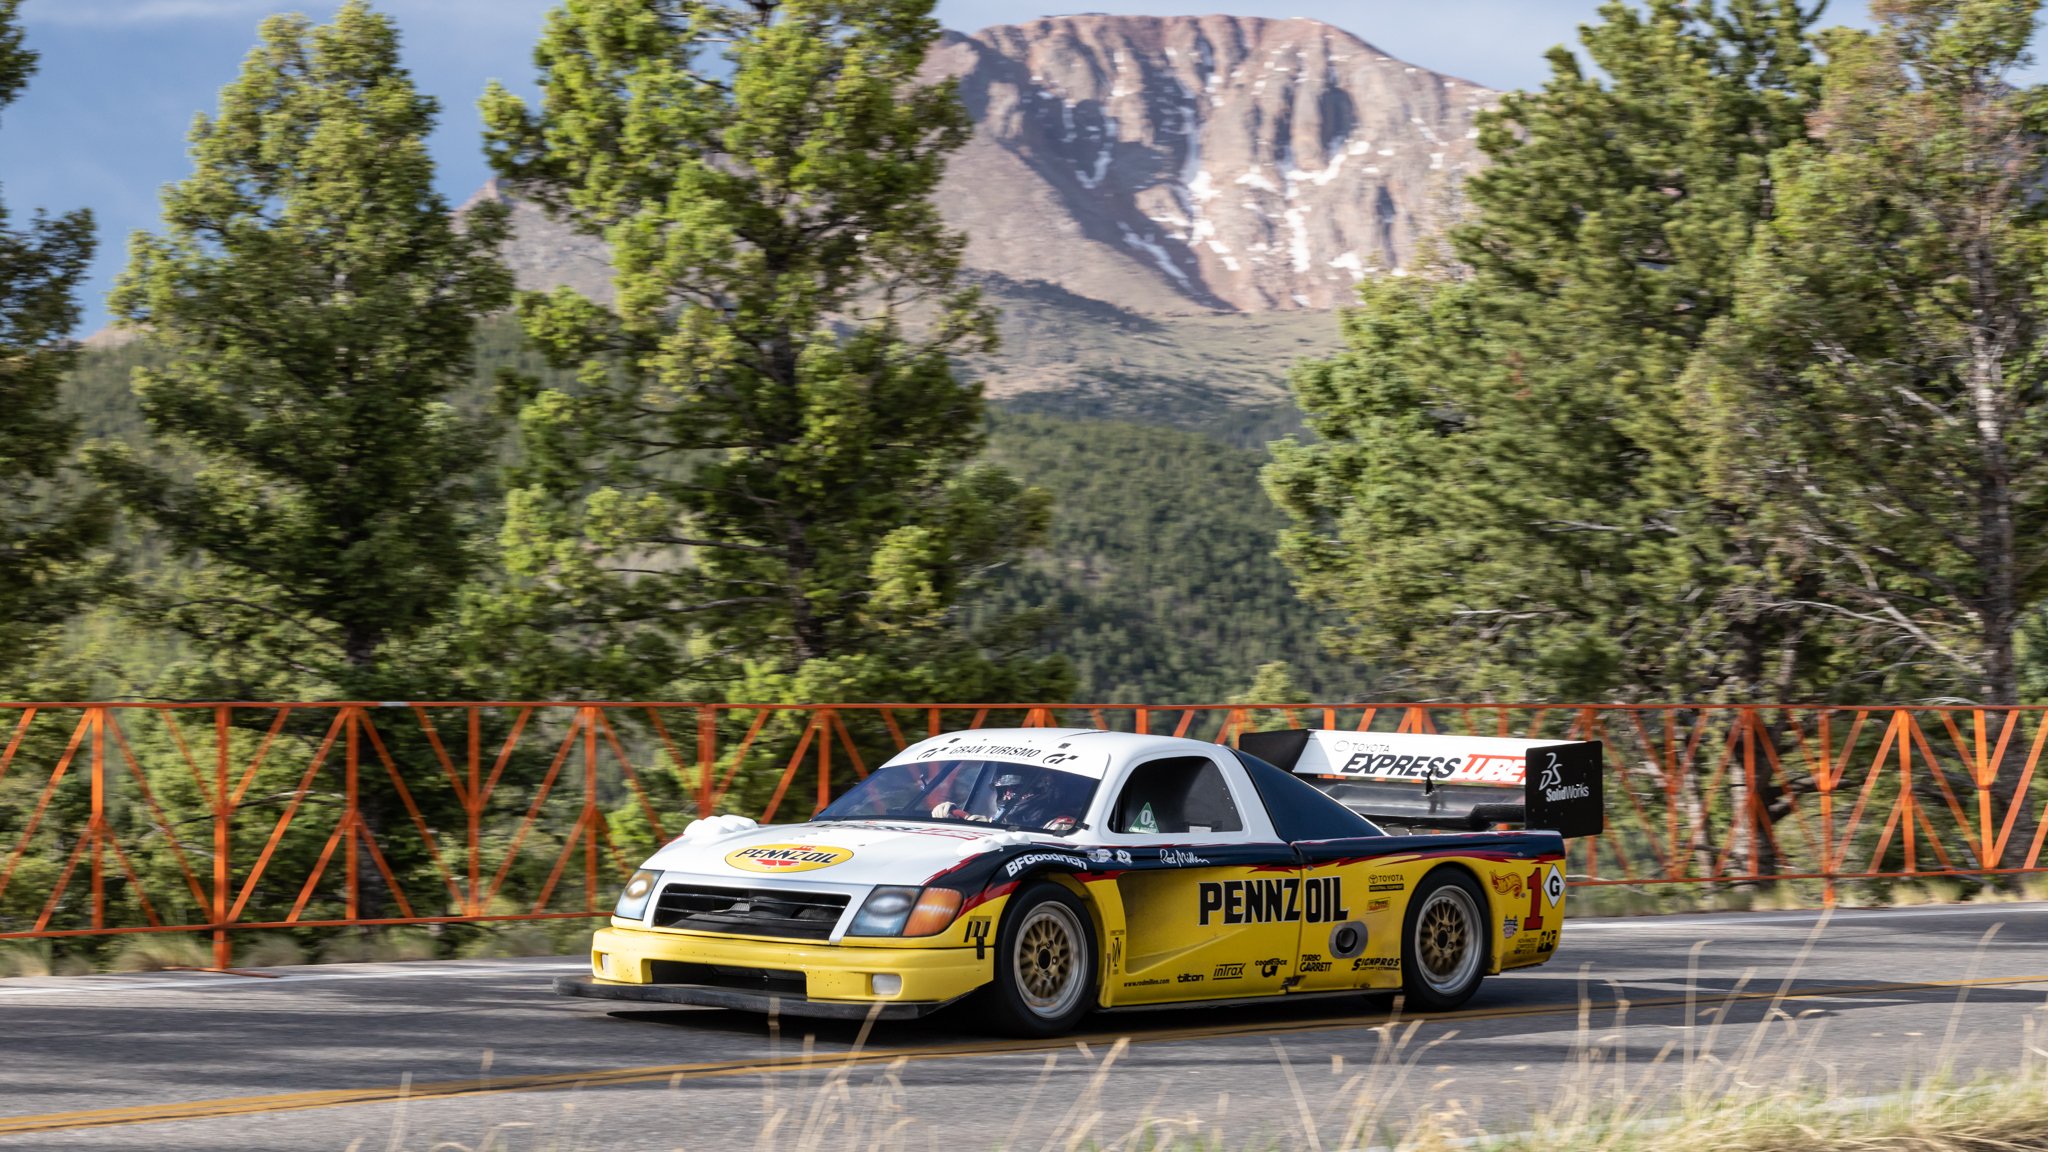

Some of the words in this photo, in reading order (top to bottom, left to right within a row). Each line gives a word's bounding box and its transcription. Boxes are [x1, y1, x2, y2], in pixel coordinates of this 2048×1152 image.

[949, 745, 987, 755] GRAN
[984, 745, 1042, 758] TURISMO
[1352, 742, 1390, 753] TOYOTA
[1340, 752, 1462, 779] EXPRESS
[1545, 784, 1590, 803] SolidWorks
[734, 848, 839, 864] PENNZOIL
[1005, 851, 1088, 878] BFGoodrich
[1378, 874, 1404, 883] TOYOTA
[1549, 875, 1560, 897] G
[1197, 876, 1350, 927] PENNZOIL
[1522, 867, 1544, 931] 1
[1301, 953, 1322, 962] TURBO
[1300, 961, 1332, 973] GARRETT
